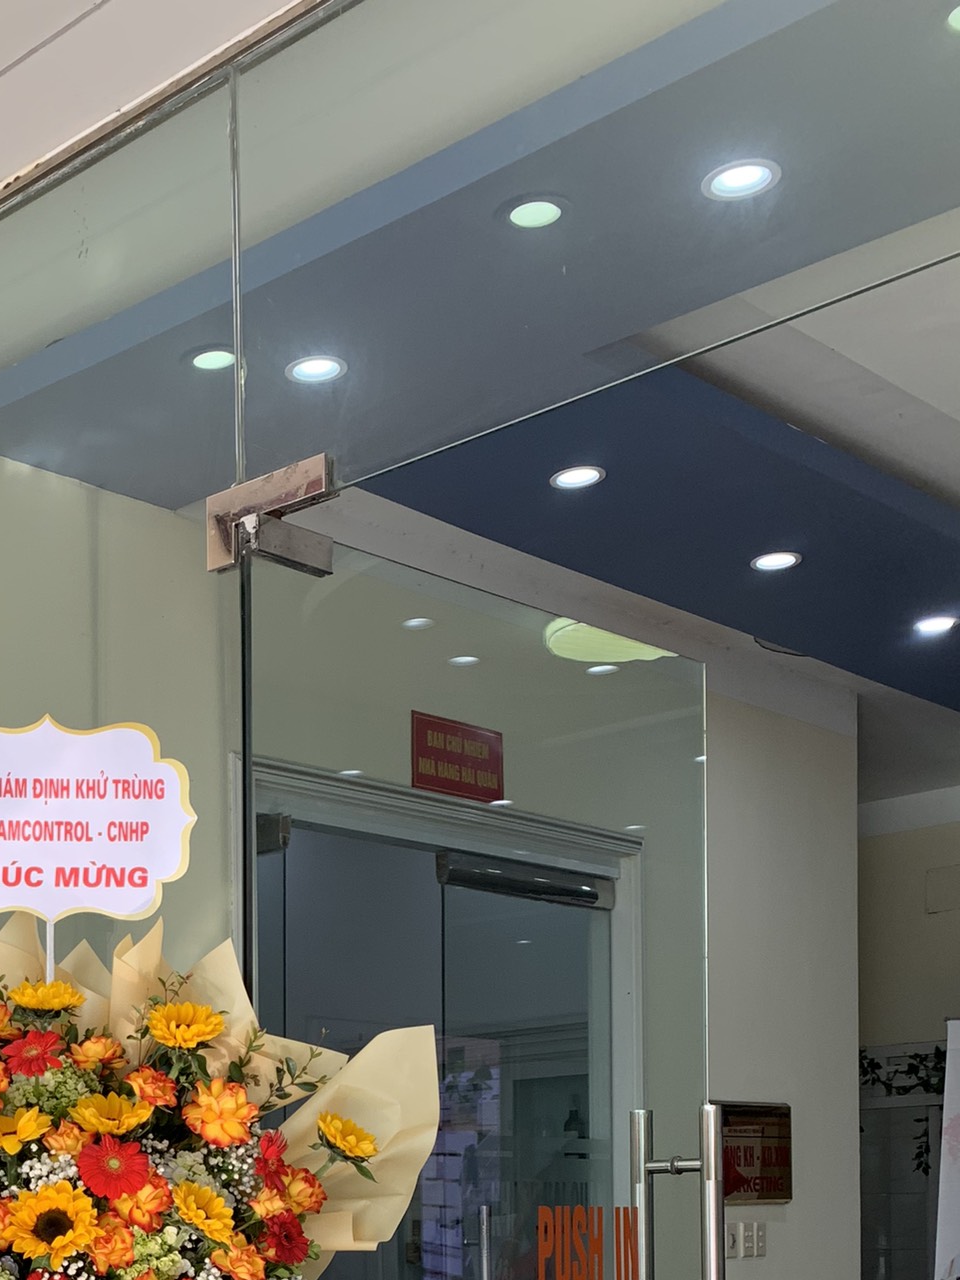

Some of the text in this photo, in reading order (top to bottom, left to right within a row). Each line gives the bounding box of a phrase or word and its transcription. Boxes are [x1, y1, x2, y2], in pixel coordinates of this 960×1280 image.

[427, 730, 445, 749] BAN
[32, 778, 70, 806] ĐỊNH
[75, 769, 109, 800] KHỬ
[112, 773, 165, 800] TRÙNG
[107, 821, 150, 842] CNHP
[54, 861, 149, 888] MỪNG
[723, 1139, 742, 1168] ÒNG
[736, 1176, 785, 1193] RKETING
